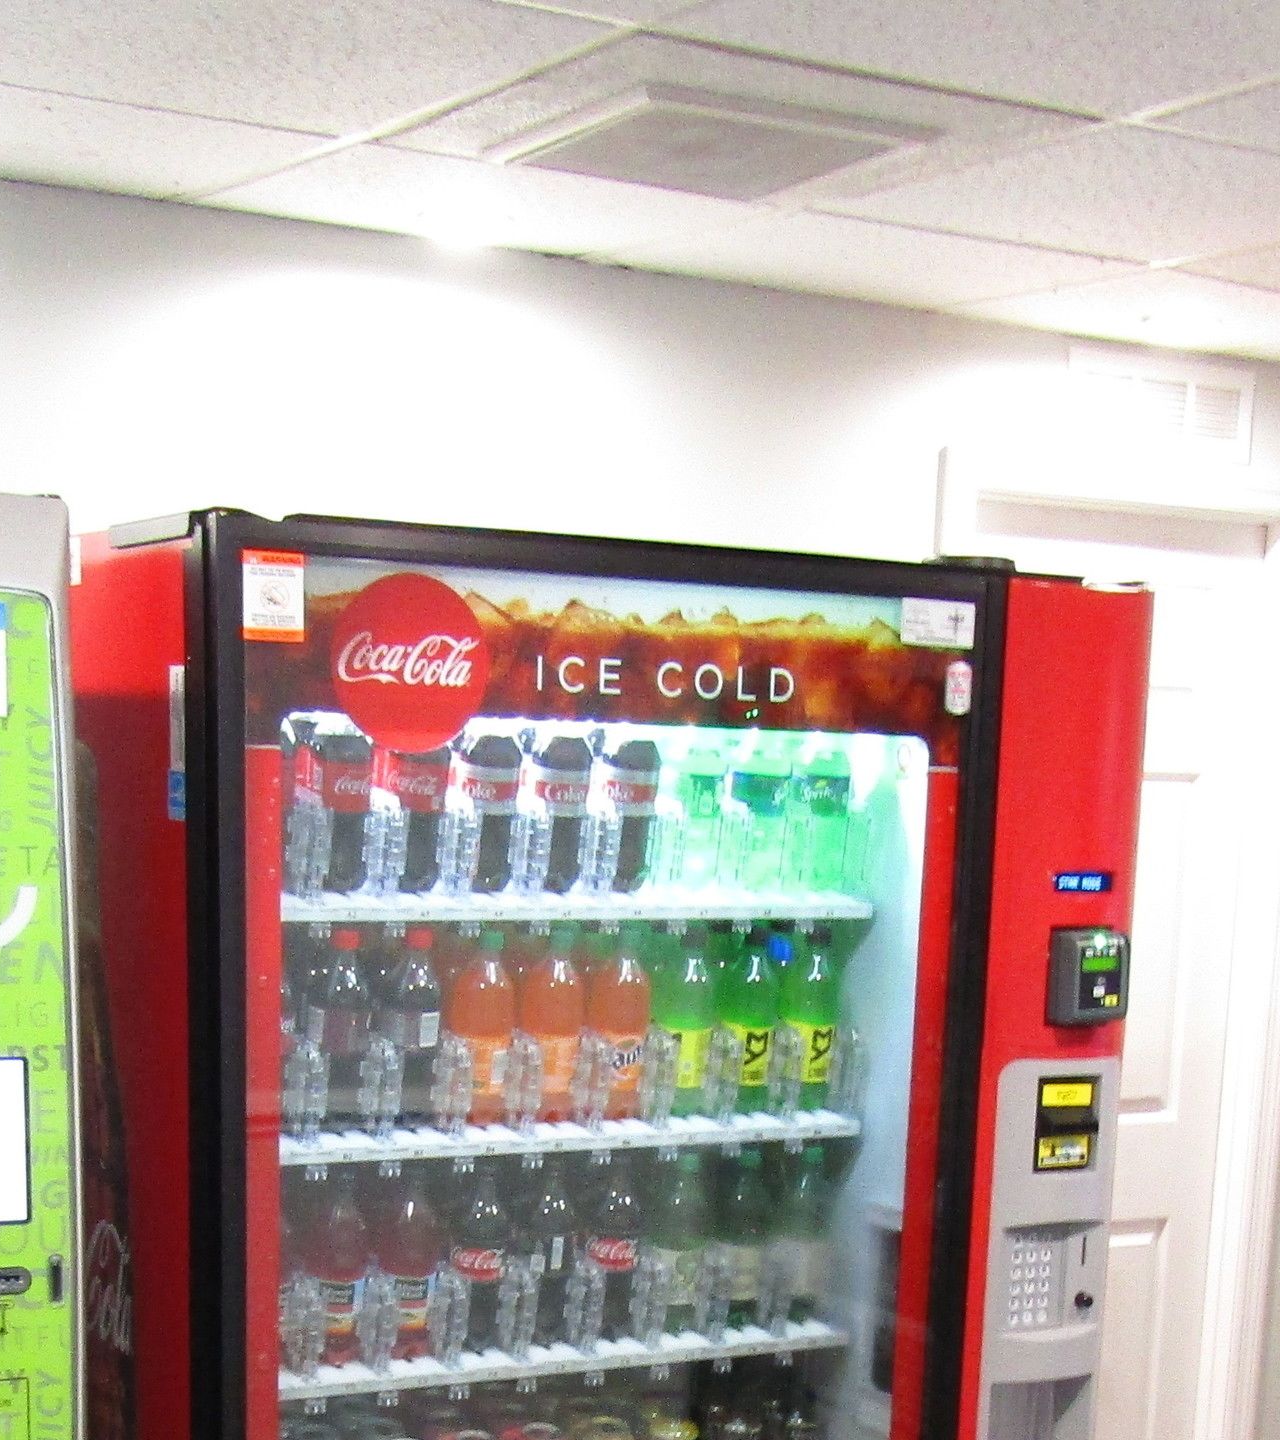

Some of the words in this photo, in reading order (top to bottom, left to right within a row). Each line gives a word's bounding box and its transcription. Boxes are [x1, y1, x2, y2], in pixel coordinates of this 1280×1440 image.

[337, 630, 480, 688] Coca-Cola
[536, 654, 623, 696] ICE
[656, 661, 796, 704] COLD
